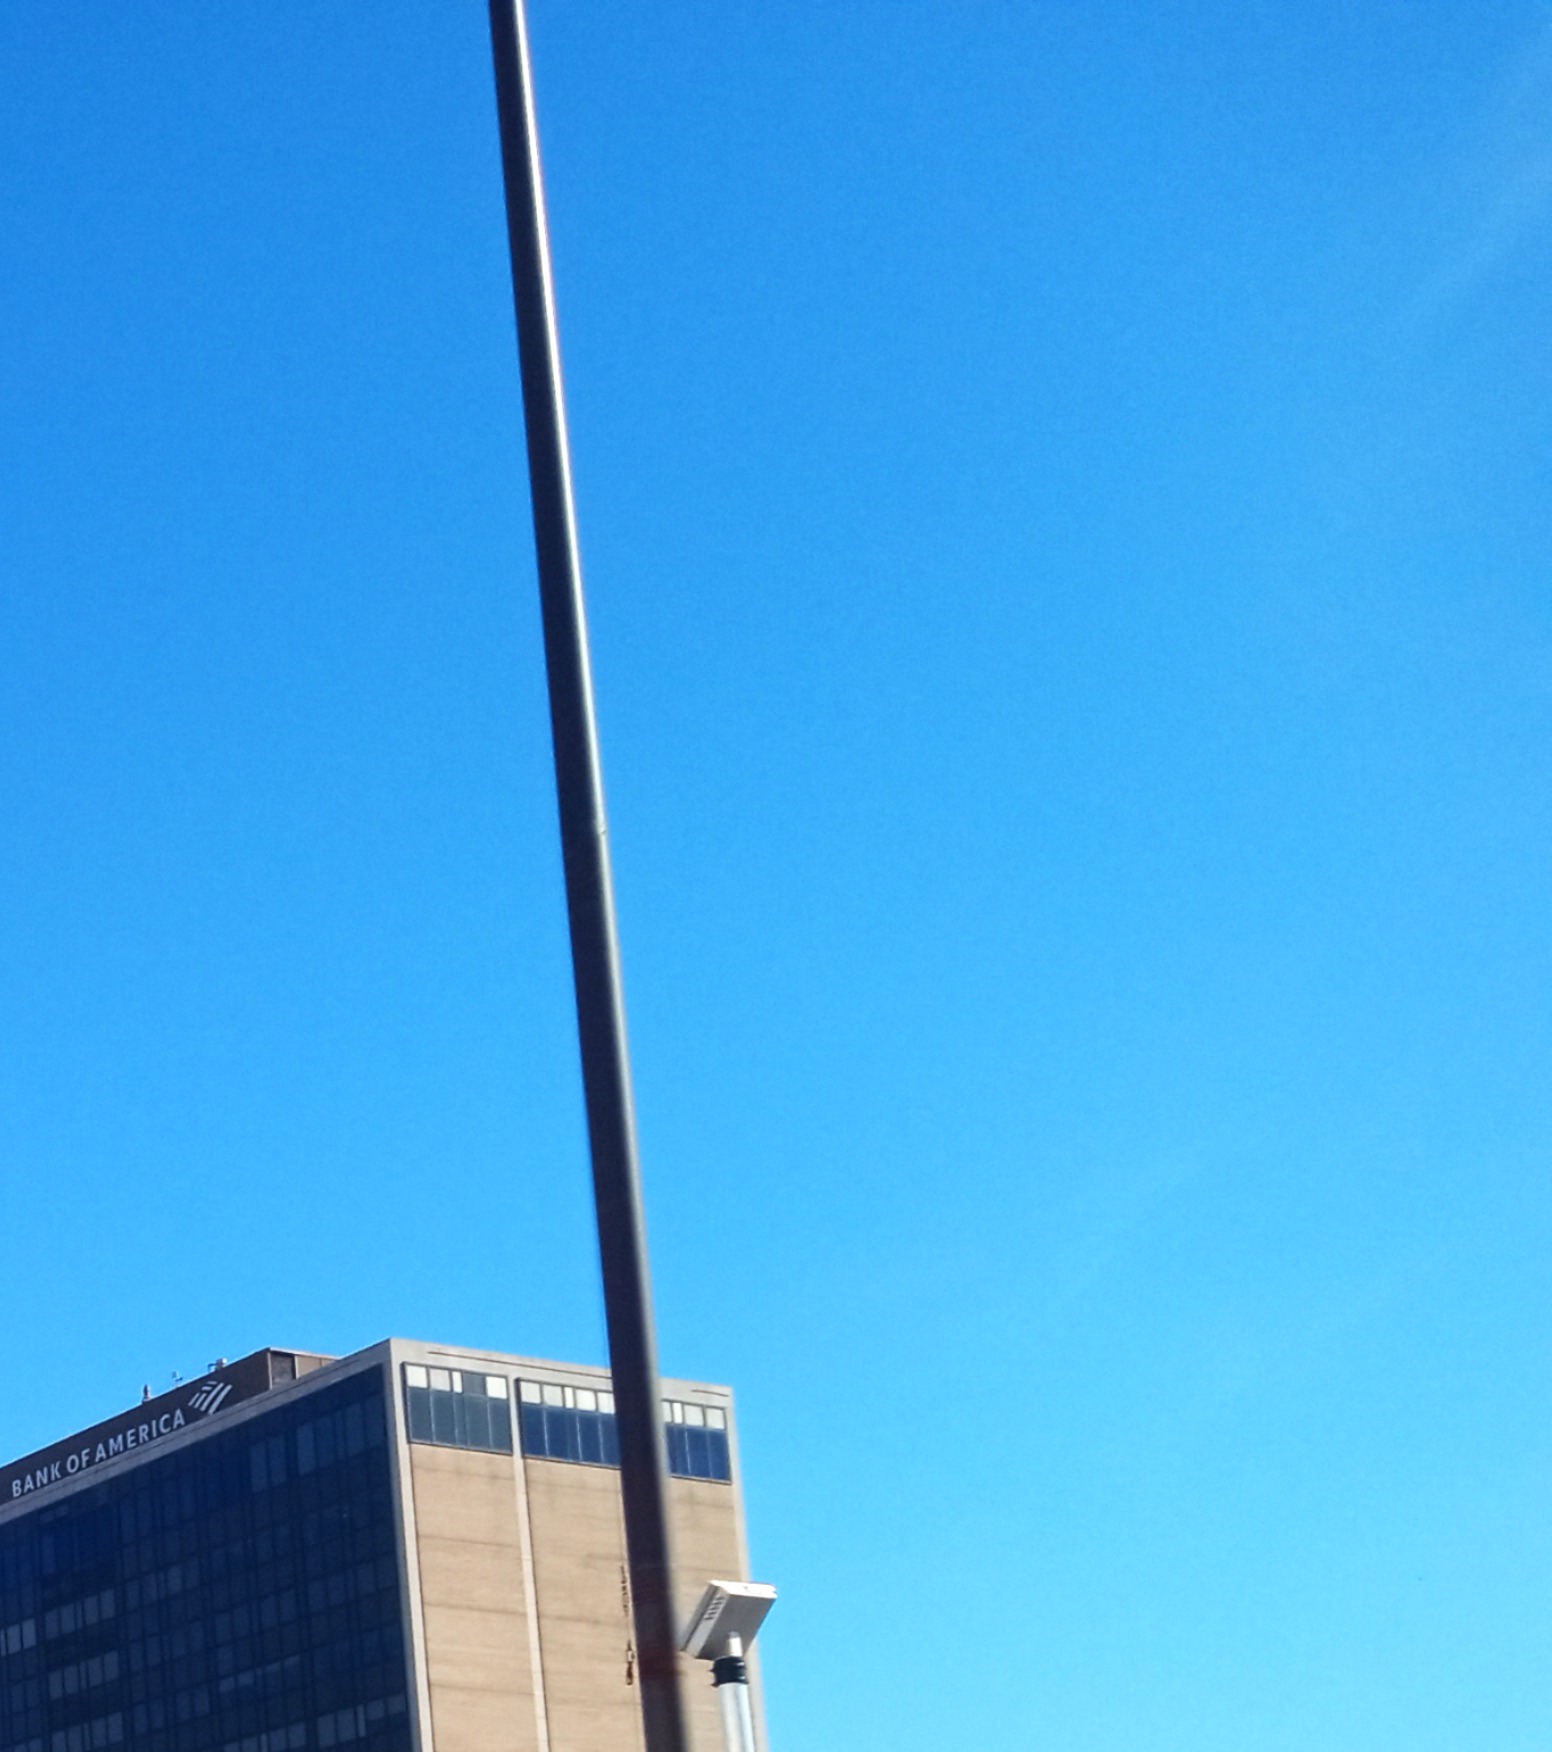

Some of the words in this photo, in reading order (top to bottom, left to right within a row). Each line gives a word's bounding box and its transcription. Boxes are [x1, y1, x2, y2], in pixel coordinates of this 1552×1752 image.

[12, 1460, 62, 1498] BANK
[66, 1448, 91, 1474] OF
[95, 1408, 186, 1463] AMERICA
